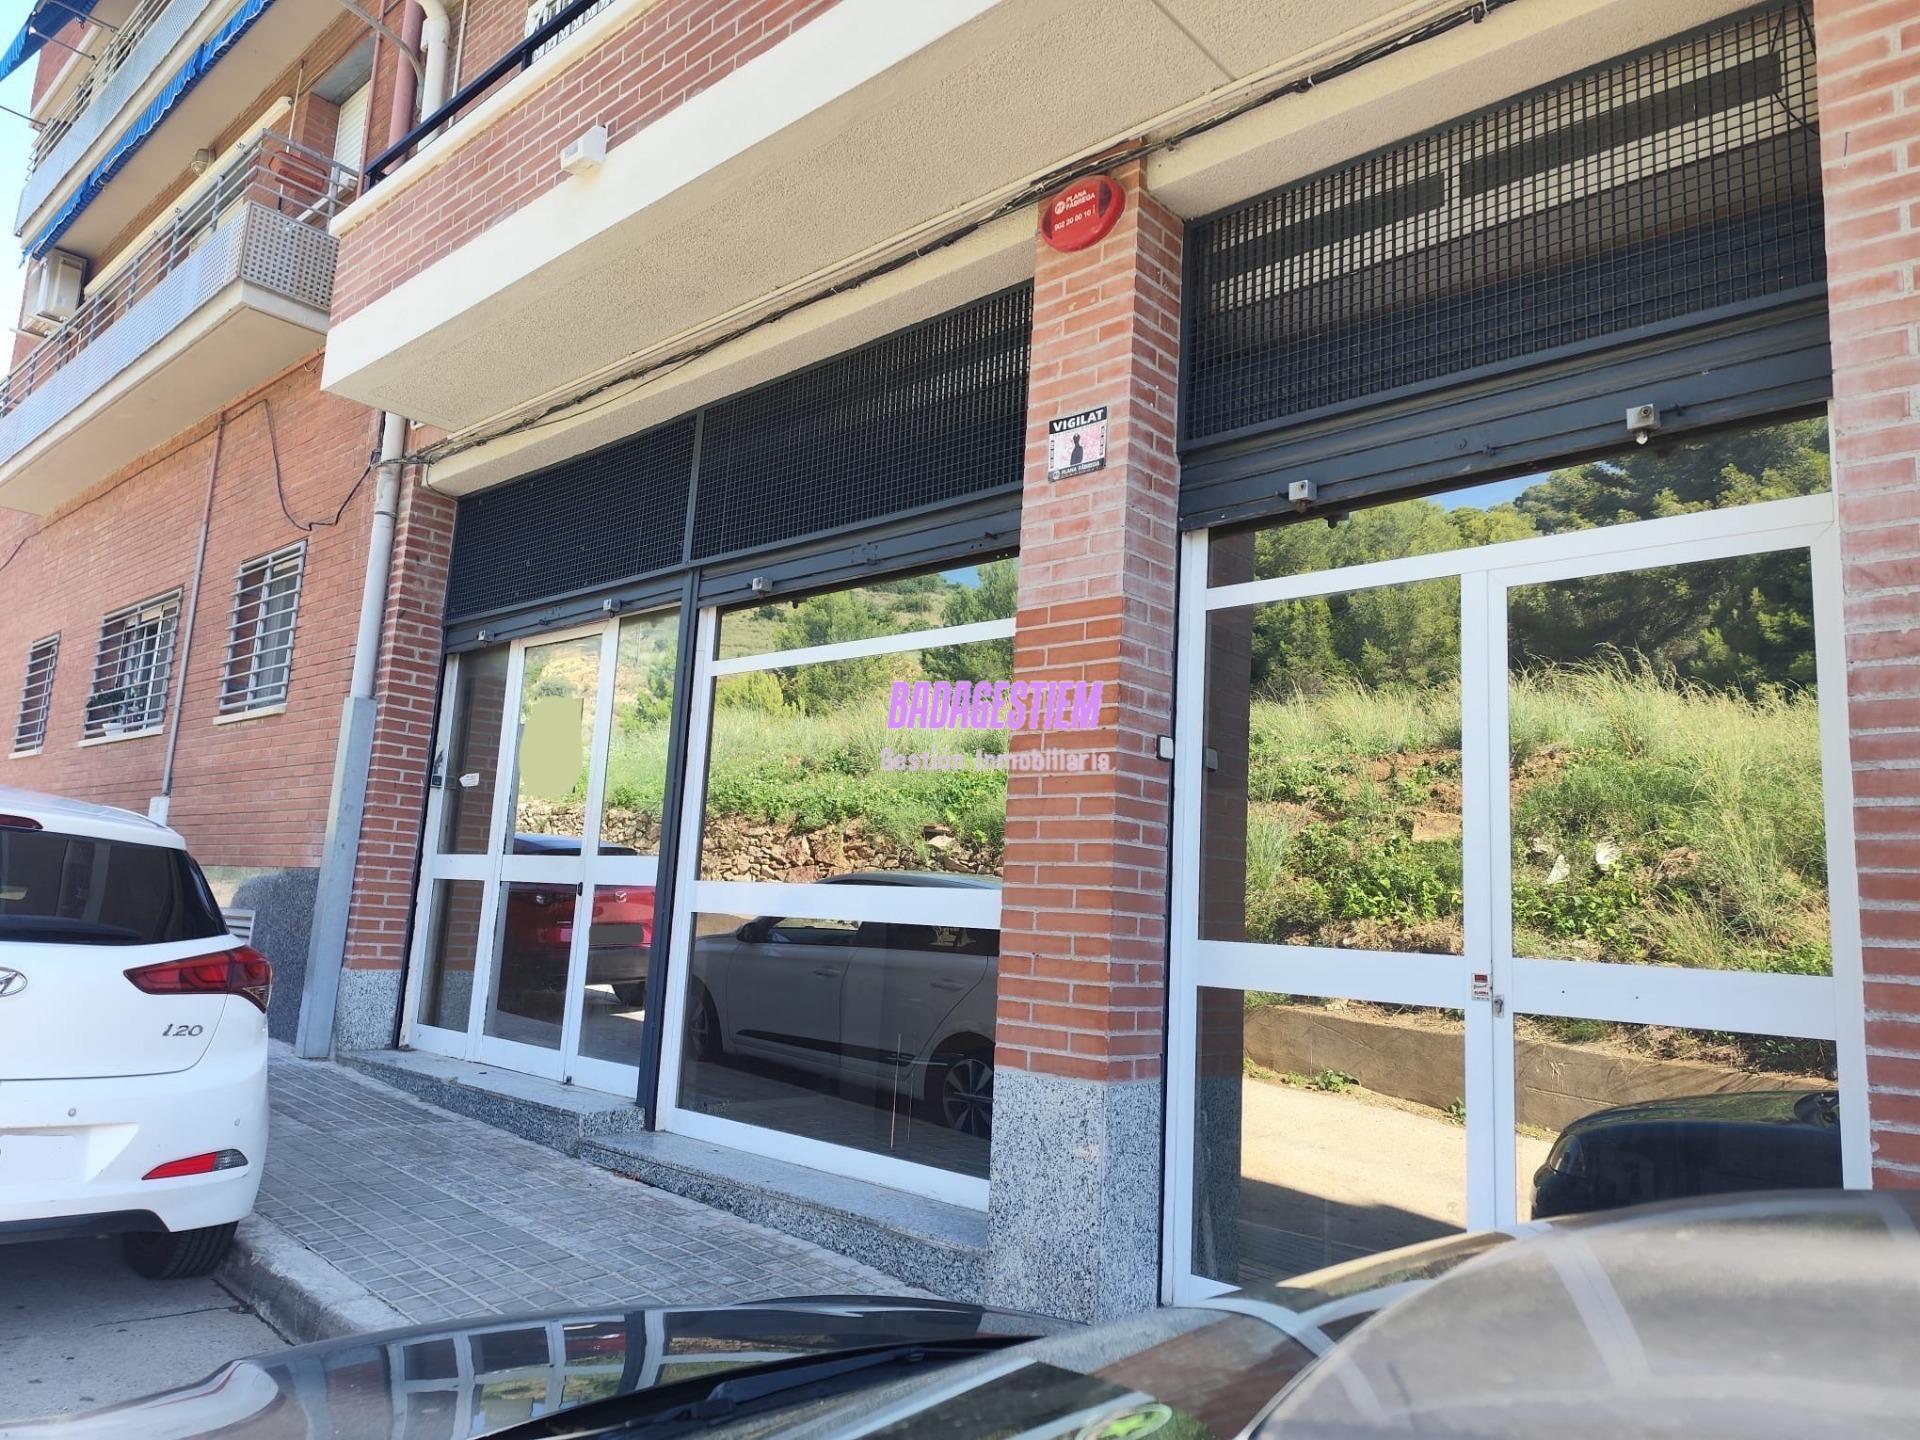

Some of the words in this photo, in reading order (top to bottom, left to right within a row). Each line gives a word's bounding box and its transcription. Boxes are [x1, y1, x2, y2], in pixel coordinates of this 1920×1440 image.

[1066, 189, 1087, 202] PLANA
[1054, 220, 1066, 231] 902
[1066, 217, 1075, 226] 20
[1075, 213, 1083, 221] 00
[1084, 209, 1092, 218] 10
[1053, 409, 1104, 431] VIGILAT
